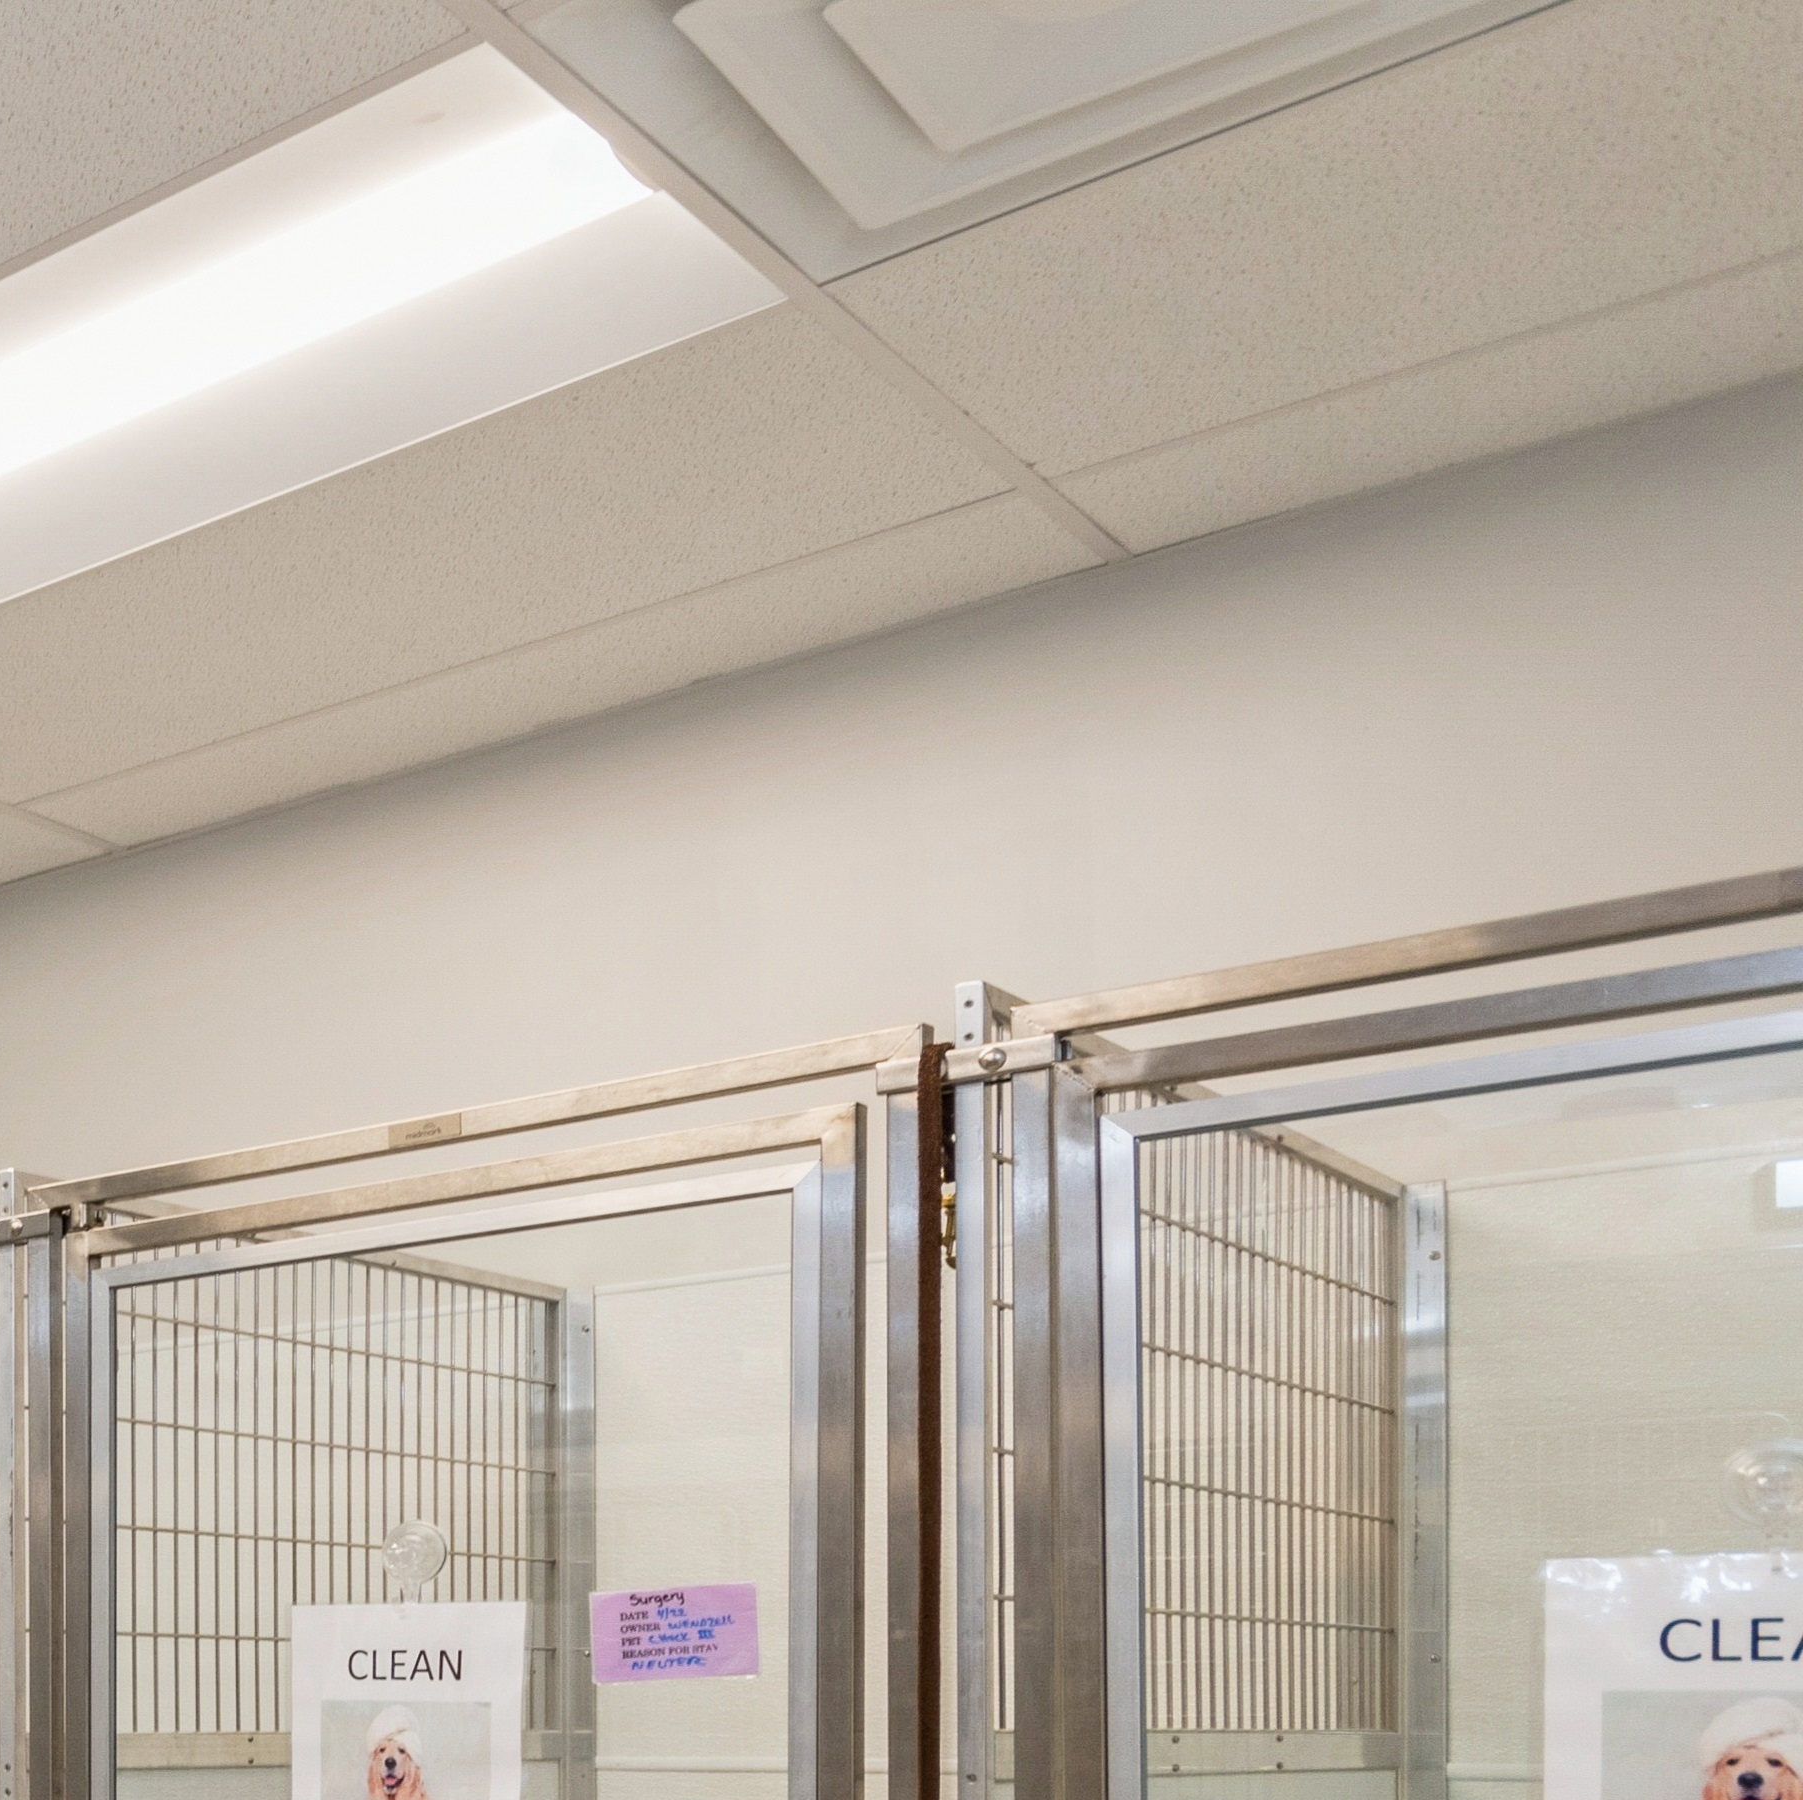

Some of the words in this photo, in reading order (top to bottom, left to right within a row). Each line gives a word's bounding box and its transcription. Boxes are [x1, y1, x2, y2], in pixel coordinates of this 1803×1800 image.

[630, 1592, 684, 1607] Surgery
[619, 1611, 649, 1622] DATE
[620, 1623, 661, 1634] OWNER
[621, 1637, 641, 1647] PET
[1659, 1617, 1803, 1662] CLE
[622, 1647, 666, 1659] REASON
[668, 1645, 691, 1656] FOR
[347, 1649, 464, 1681] CLEAN
